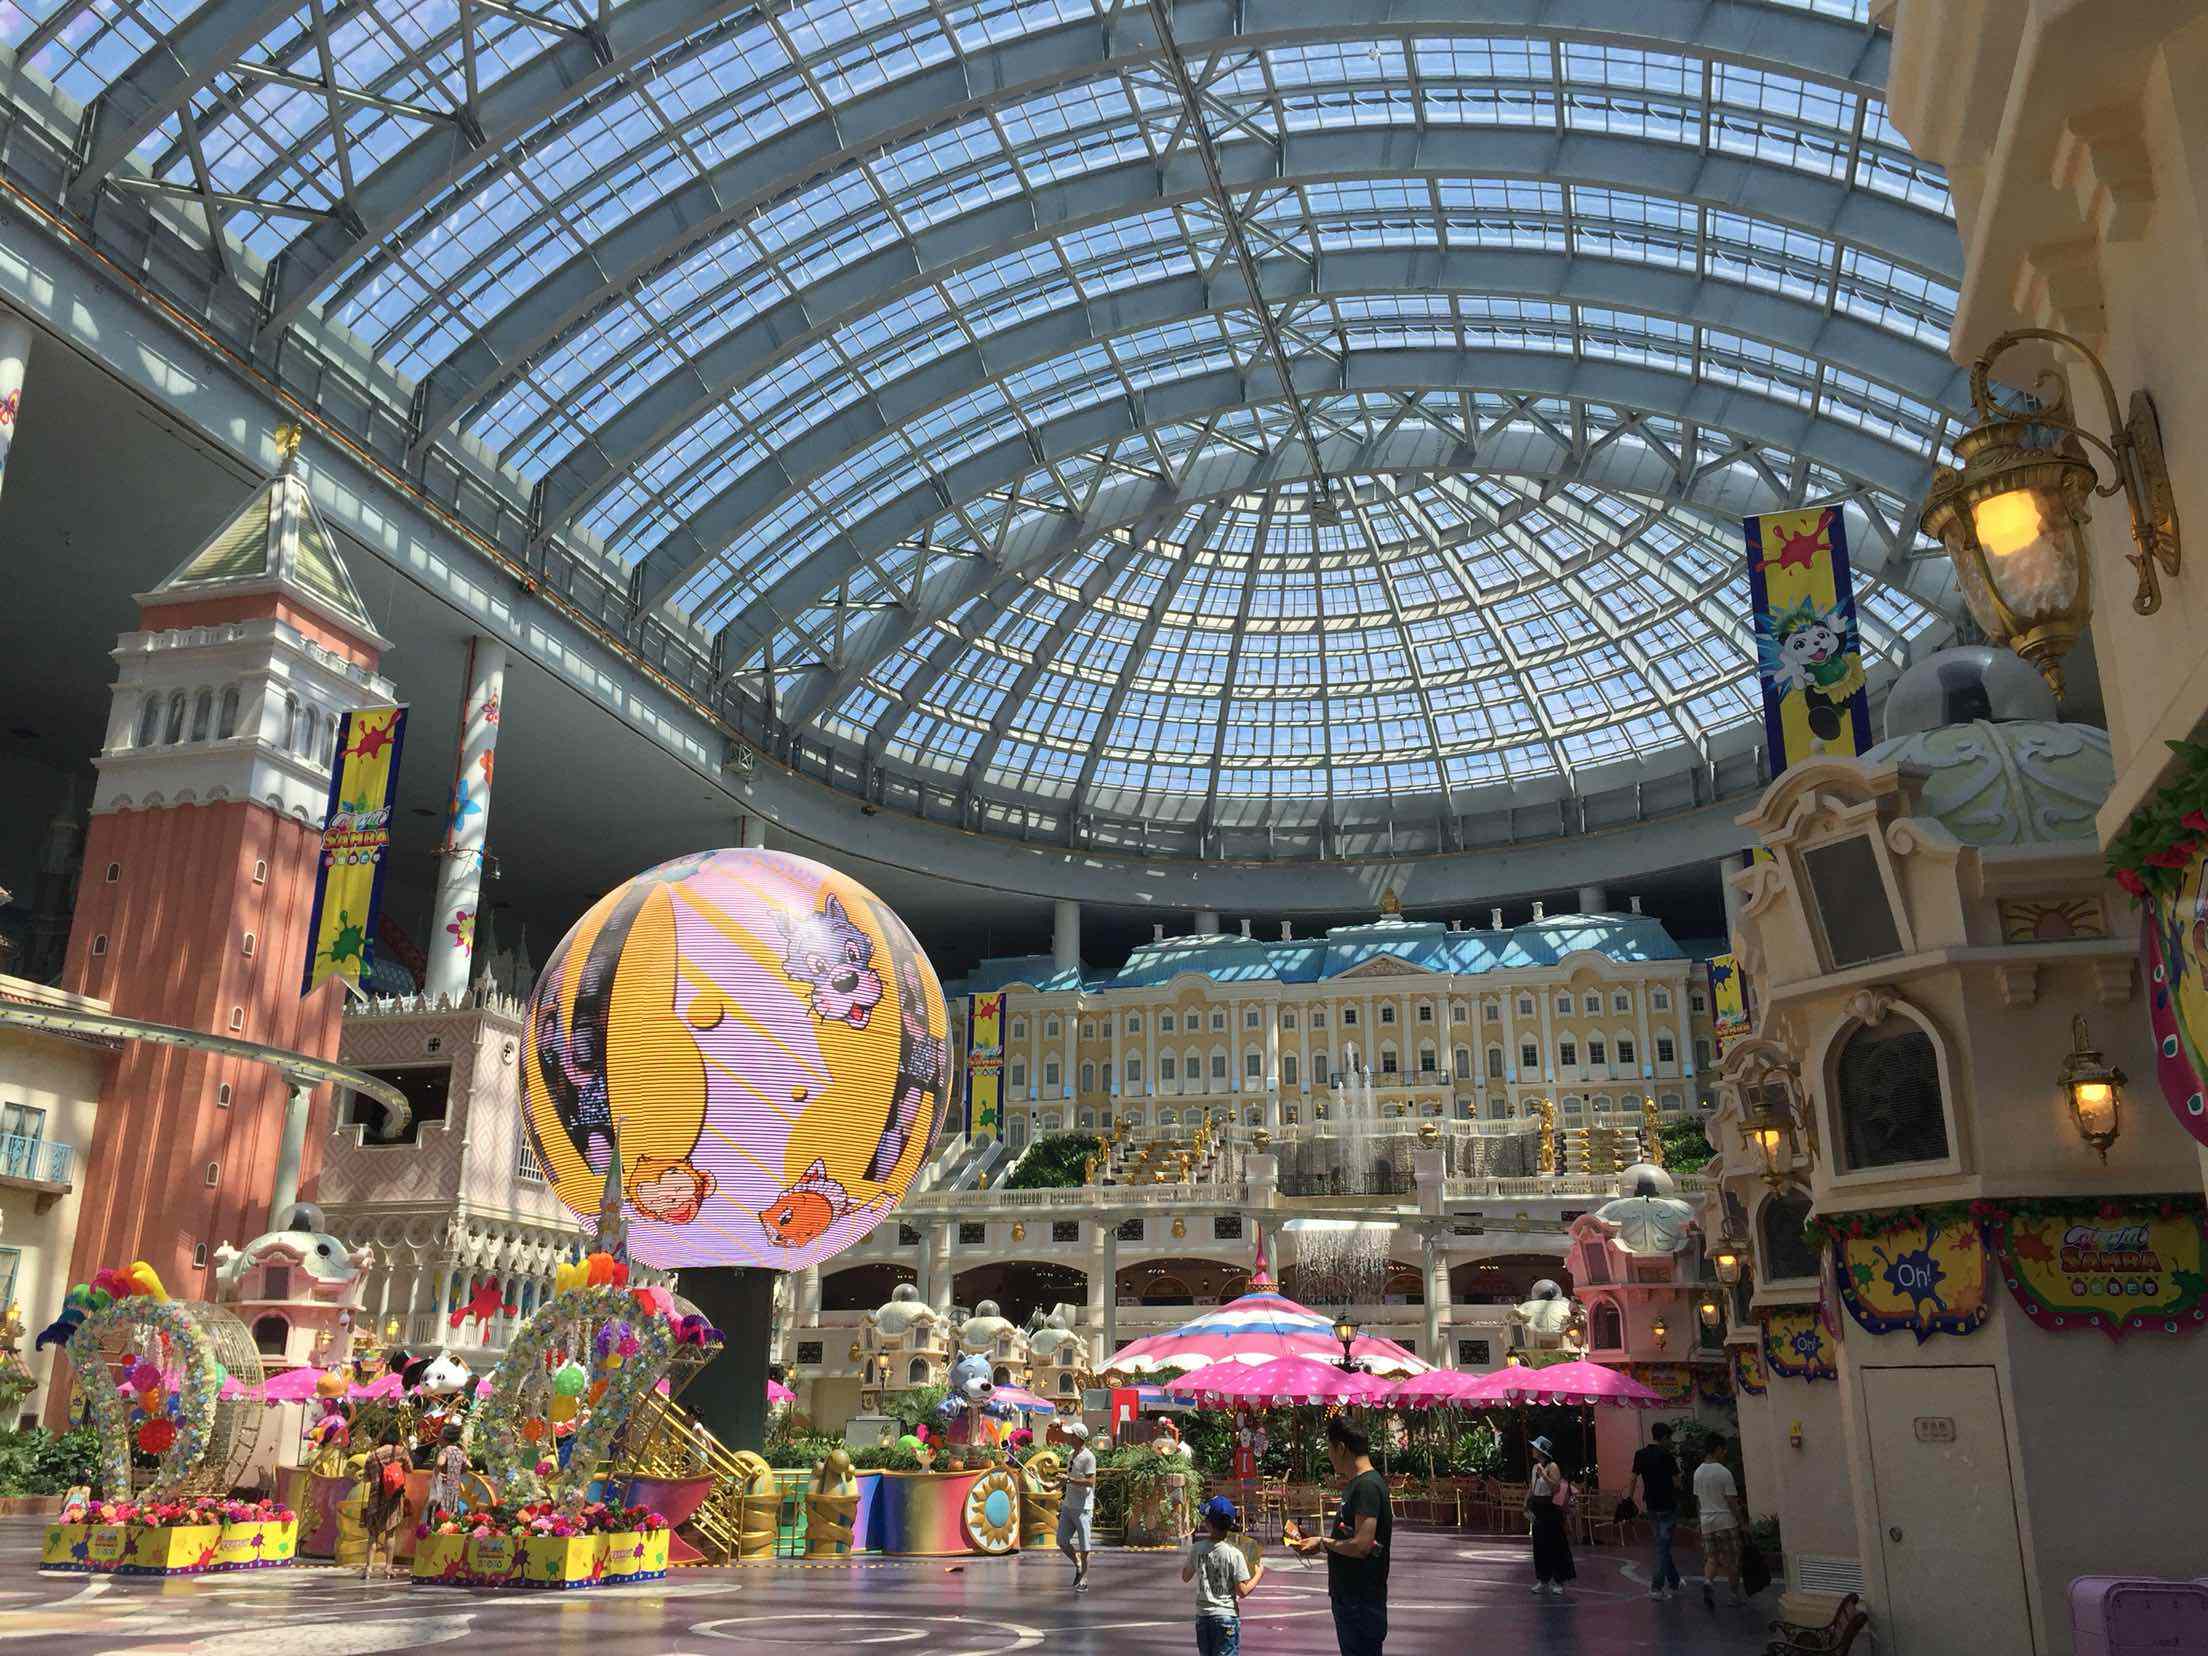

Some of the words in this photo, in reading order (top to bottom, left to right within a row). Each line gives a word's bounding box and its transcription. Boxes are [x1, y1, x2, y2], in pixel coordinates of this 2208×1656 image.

[322, 830, 390, 849] SAMBA
[2061, 1248, 2164, 1272] SAMBA
[1897, 1263, 1932, 1289] Oh!
[1796, 1336, 1817, 1352] Oh!
